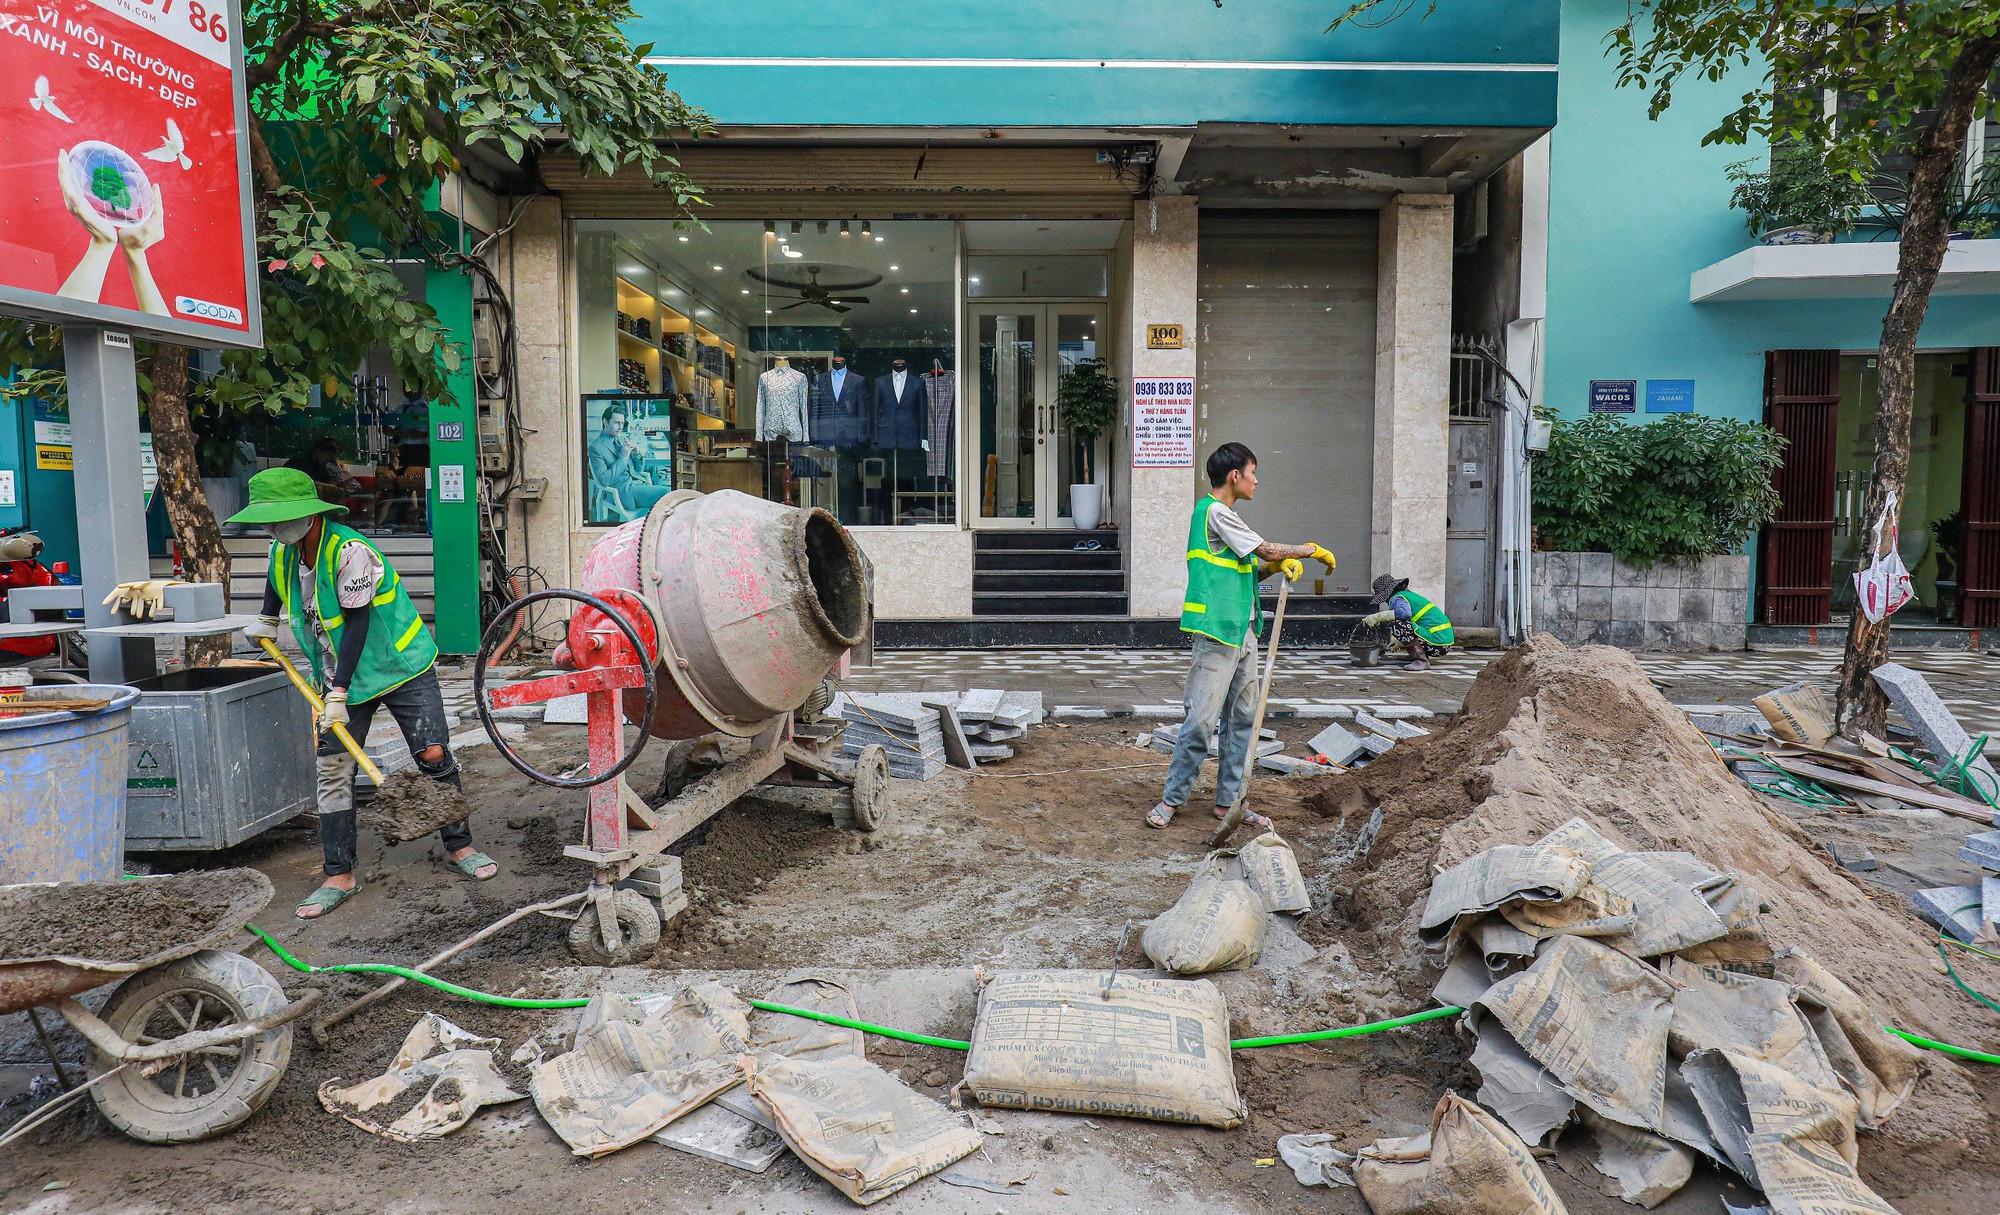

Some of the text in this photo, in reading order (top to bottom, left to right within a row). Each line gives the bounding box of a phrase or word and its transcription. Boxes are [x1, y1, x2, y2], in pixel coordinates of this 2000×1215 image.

[189, 1, 227, 43] 86
[37, 5, 195, 89] VÌ MÔI TRƯỜNG
[0, 13, 66, 55] XANH
[86, 52, 143, 88] SẠCH
[159, 84, 197, 109] ĐẸP
[196, 304, 237, 321] GODA
[1152, 327, 1178, 339] 100
[1136, 382, 1192, 395] 0936 833 833
[440, 425, 460, 438] 102
[351, 575, 369, 586] VISIT
